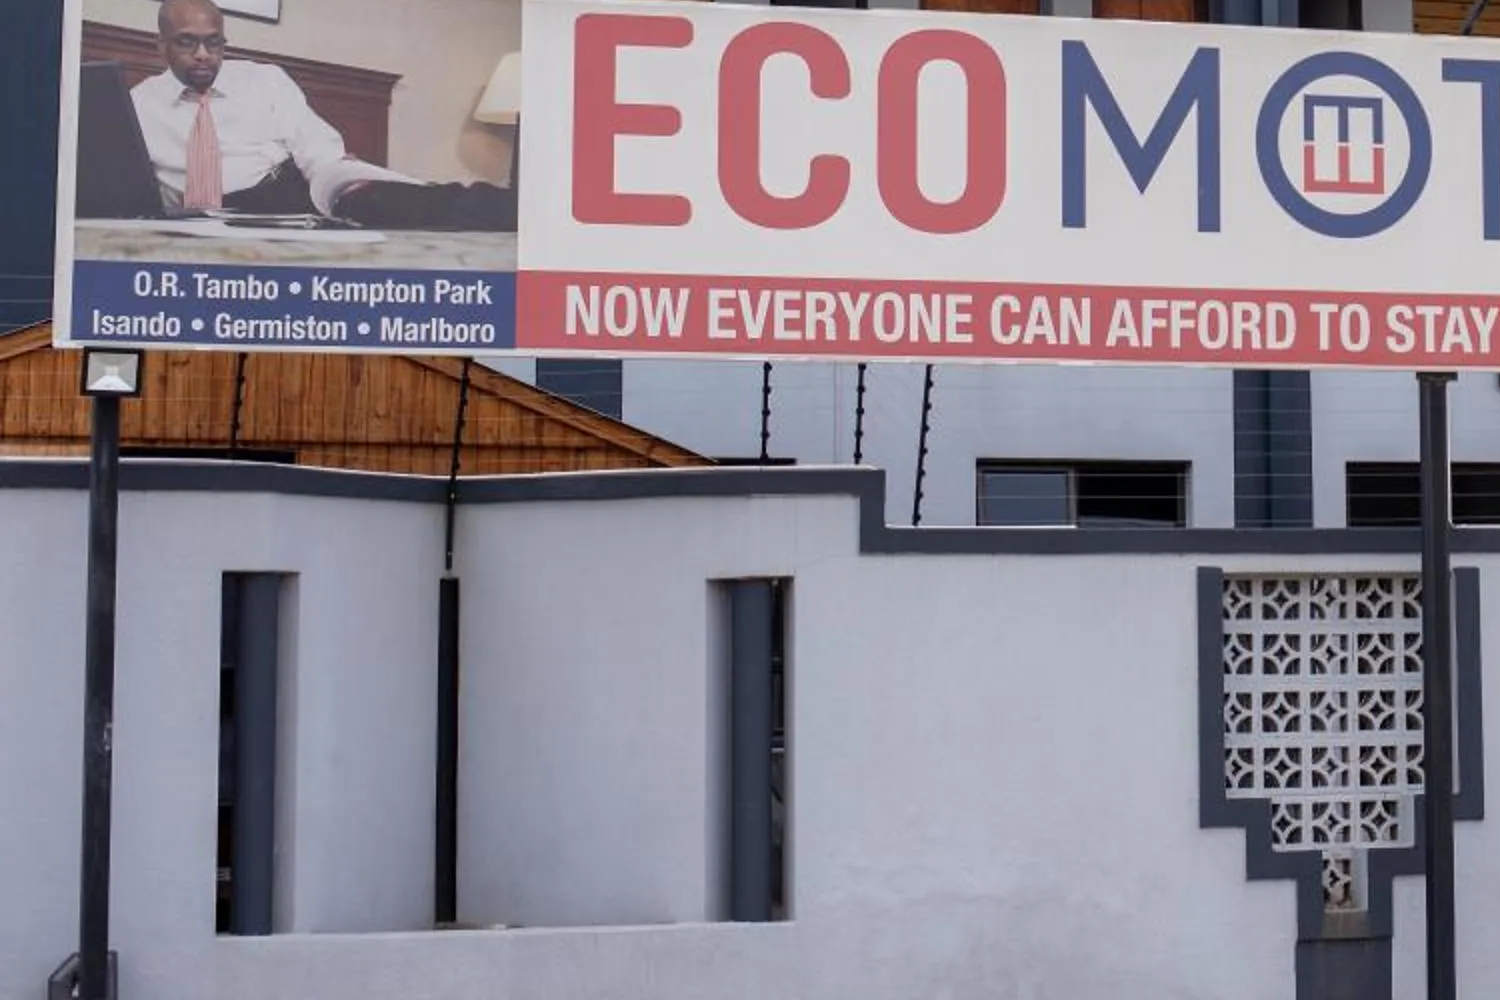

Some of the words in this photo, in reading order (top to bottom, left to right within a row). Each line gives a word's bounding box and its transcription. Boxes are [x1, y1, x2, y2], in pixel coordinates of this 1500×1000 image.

[571, 13, 1008, 235] ECO
[133, 271, 185, 298] O.R.
[193, 272, 279, 300] Tambo
[310, 276, 426, 308] Kempton
[434, 279, 494, 305] Park
[92, 310, 182, 338] Isando
[214, 312, 347, 342] Germiston
[380, 316, 496, 344] Marlboro
[565, 285, 690, 338] NOW
[707, 288, 974, 344] EVERYONE
[989, 294, 1091, 346] CAN
[1106, 298, 1297, 351] AFFORD
[1310, 302, 1371, 352] TO
[1386, 303, 1500, 354] STAY
